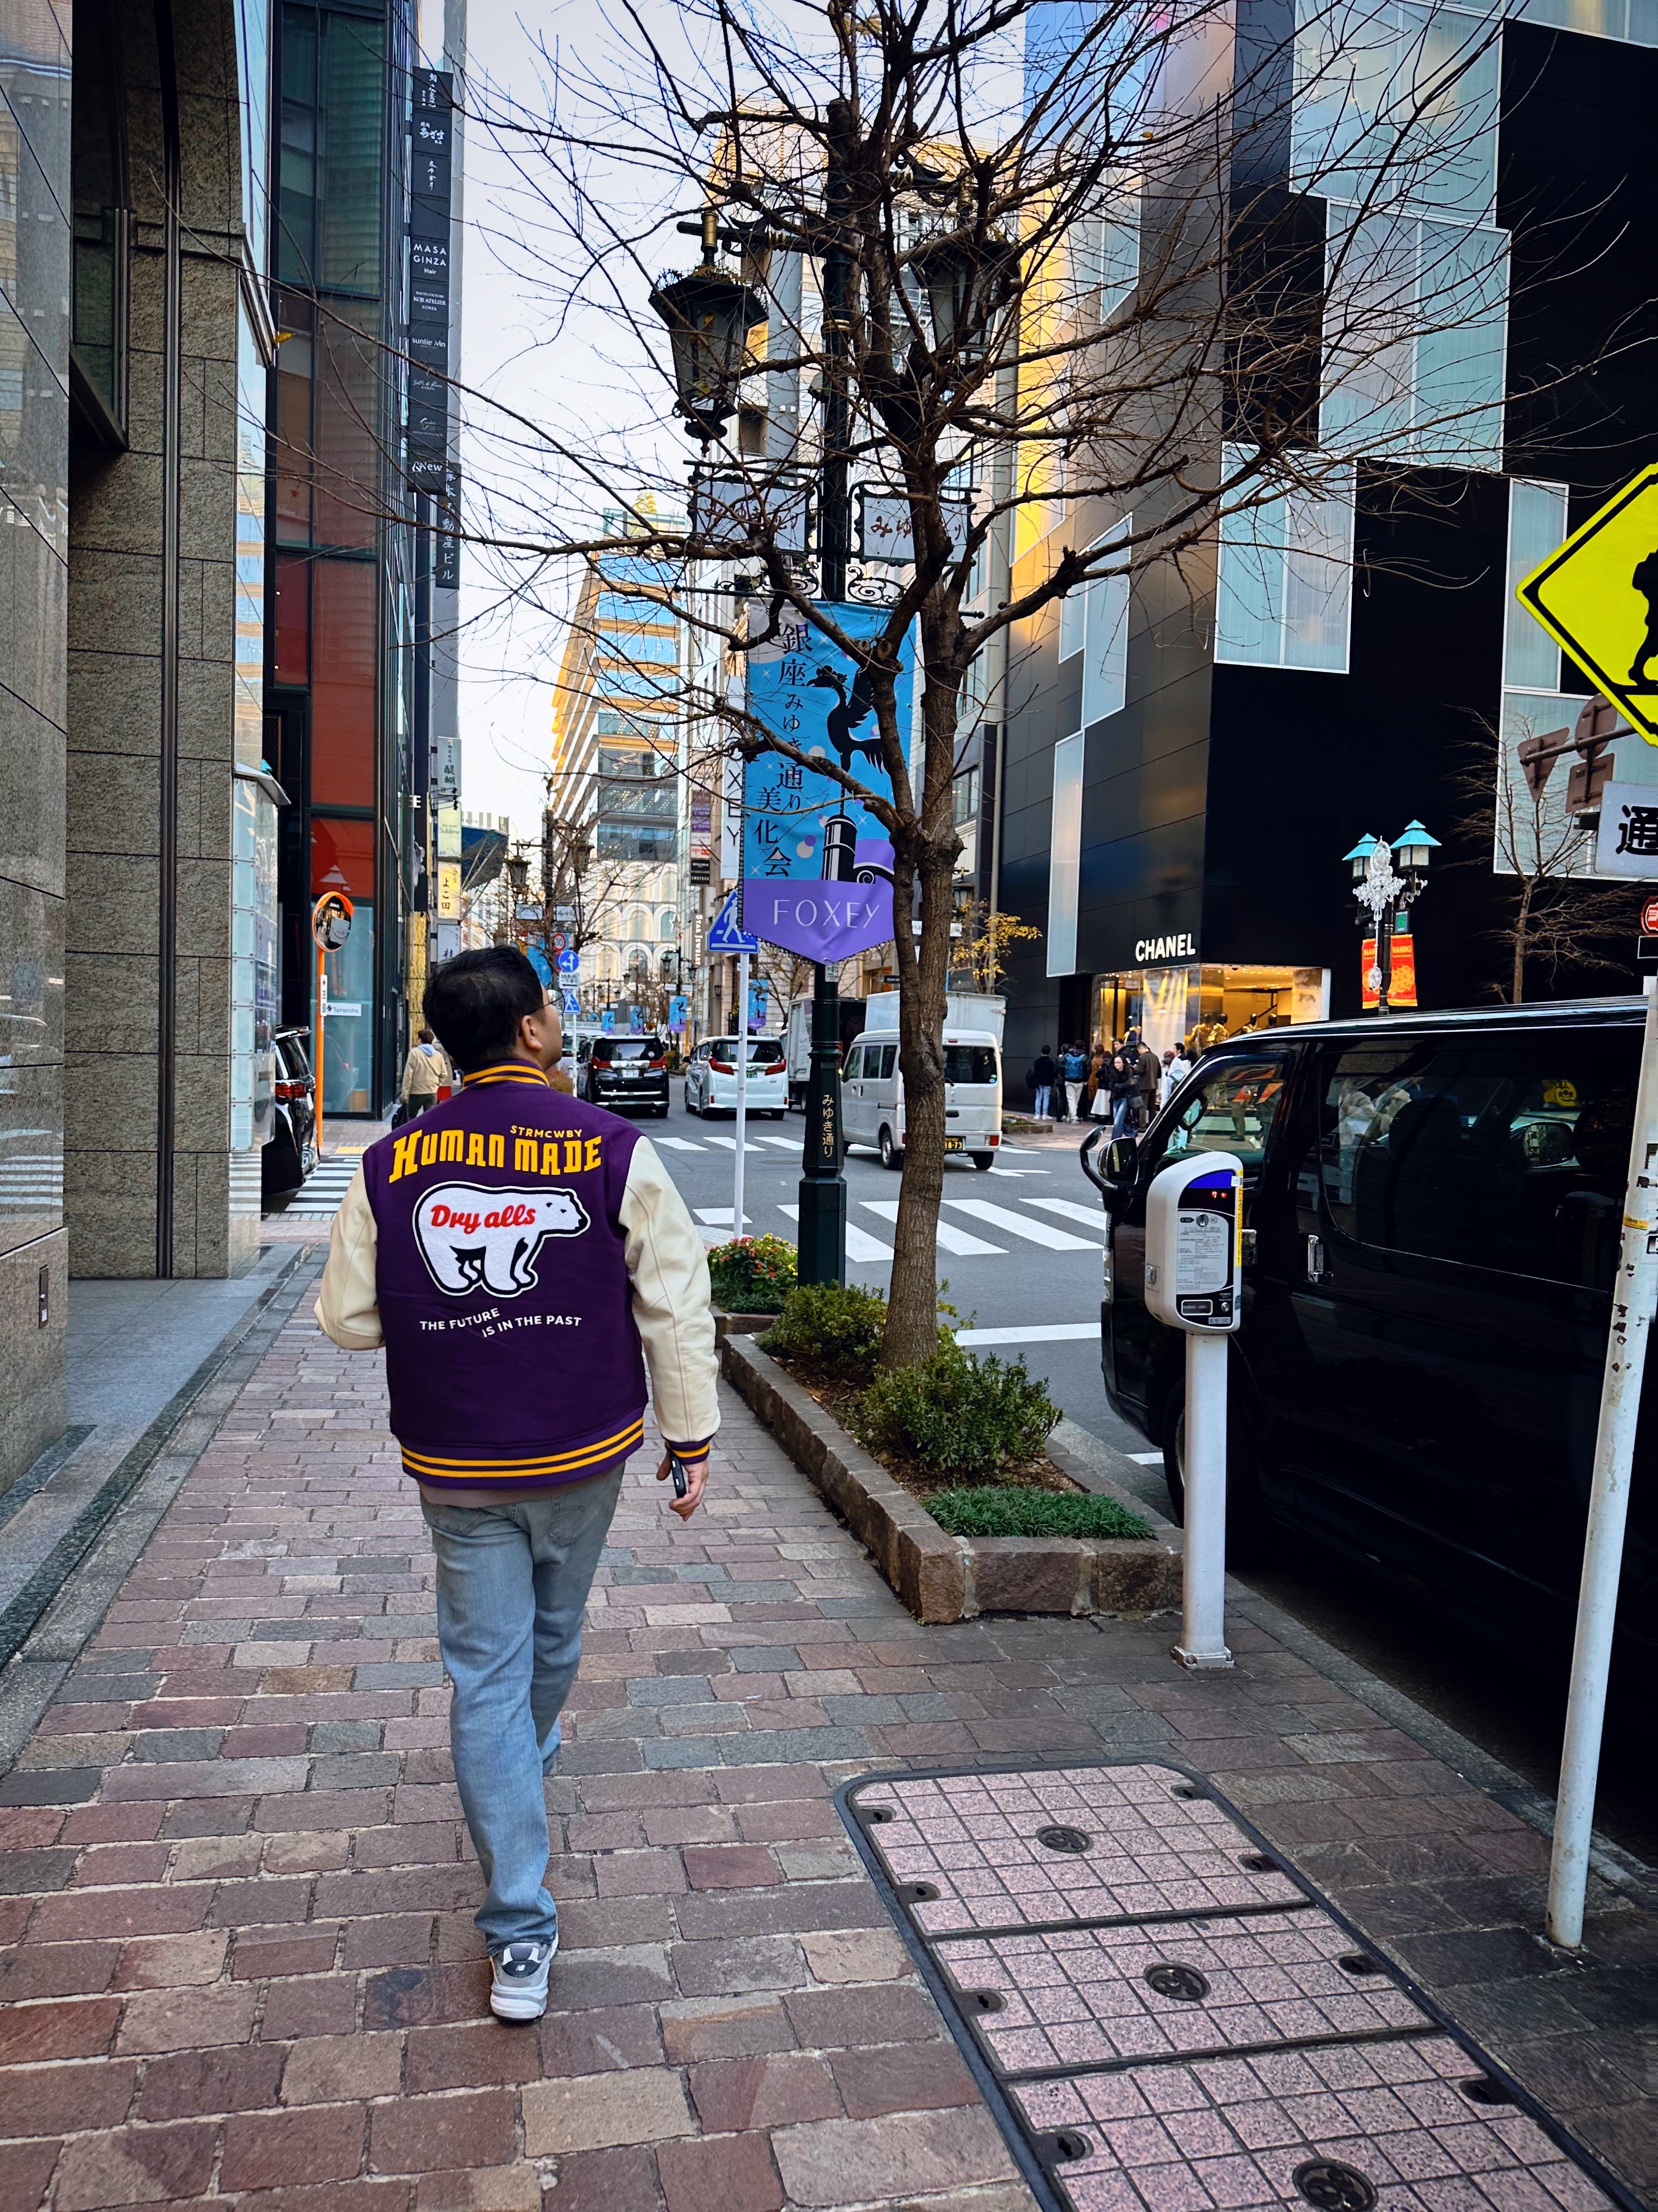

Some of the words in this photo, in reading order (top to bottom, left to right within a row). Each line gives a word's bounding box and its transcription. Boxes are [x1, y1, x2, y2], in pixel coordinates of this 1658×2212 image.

[414, 244, 447, 255] MASA
[414, 255, 447, 267] GINZA
[870, 516, 961, 540] みゆり
[753, 786, 793, 877] 美化会
[441, 878, 451, 910] よこ田
[774, 899, 880, 929] FOXEY
[555, 938, 563, 946] 30
[694, 935, 703, 966] JEWELRY
[1135, 933, 1195, 962] CHANEL
[510, 1125, 583, 1138] STRMCWBY
[822, 1094, 834, 1158] みゆき通り
[388, 1129, 505, 1183] HUMAN
[515, 1135, 602, 1175] MADE
[420, 1321, 445, 1330] THE
[449, 1307, 500, 1329] FUTURE
[482, 1325, 495, 1338] IS
[497, 1320, 513, 1333] IN
[515, 1315, 542, 1327] THE
[546, 1315, 582, 1327] PAST
